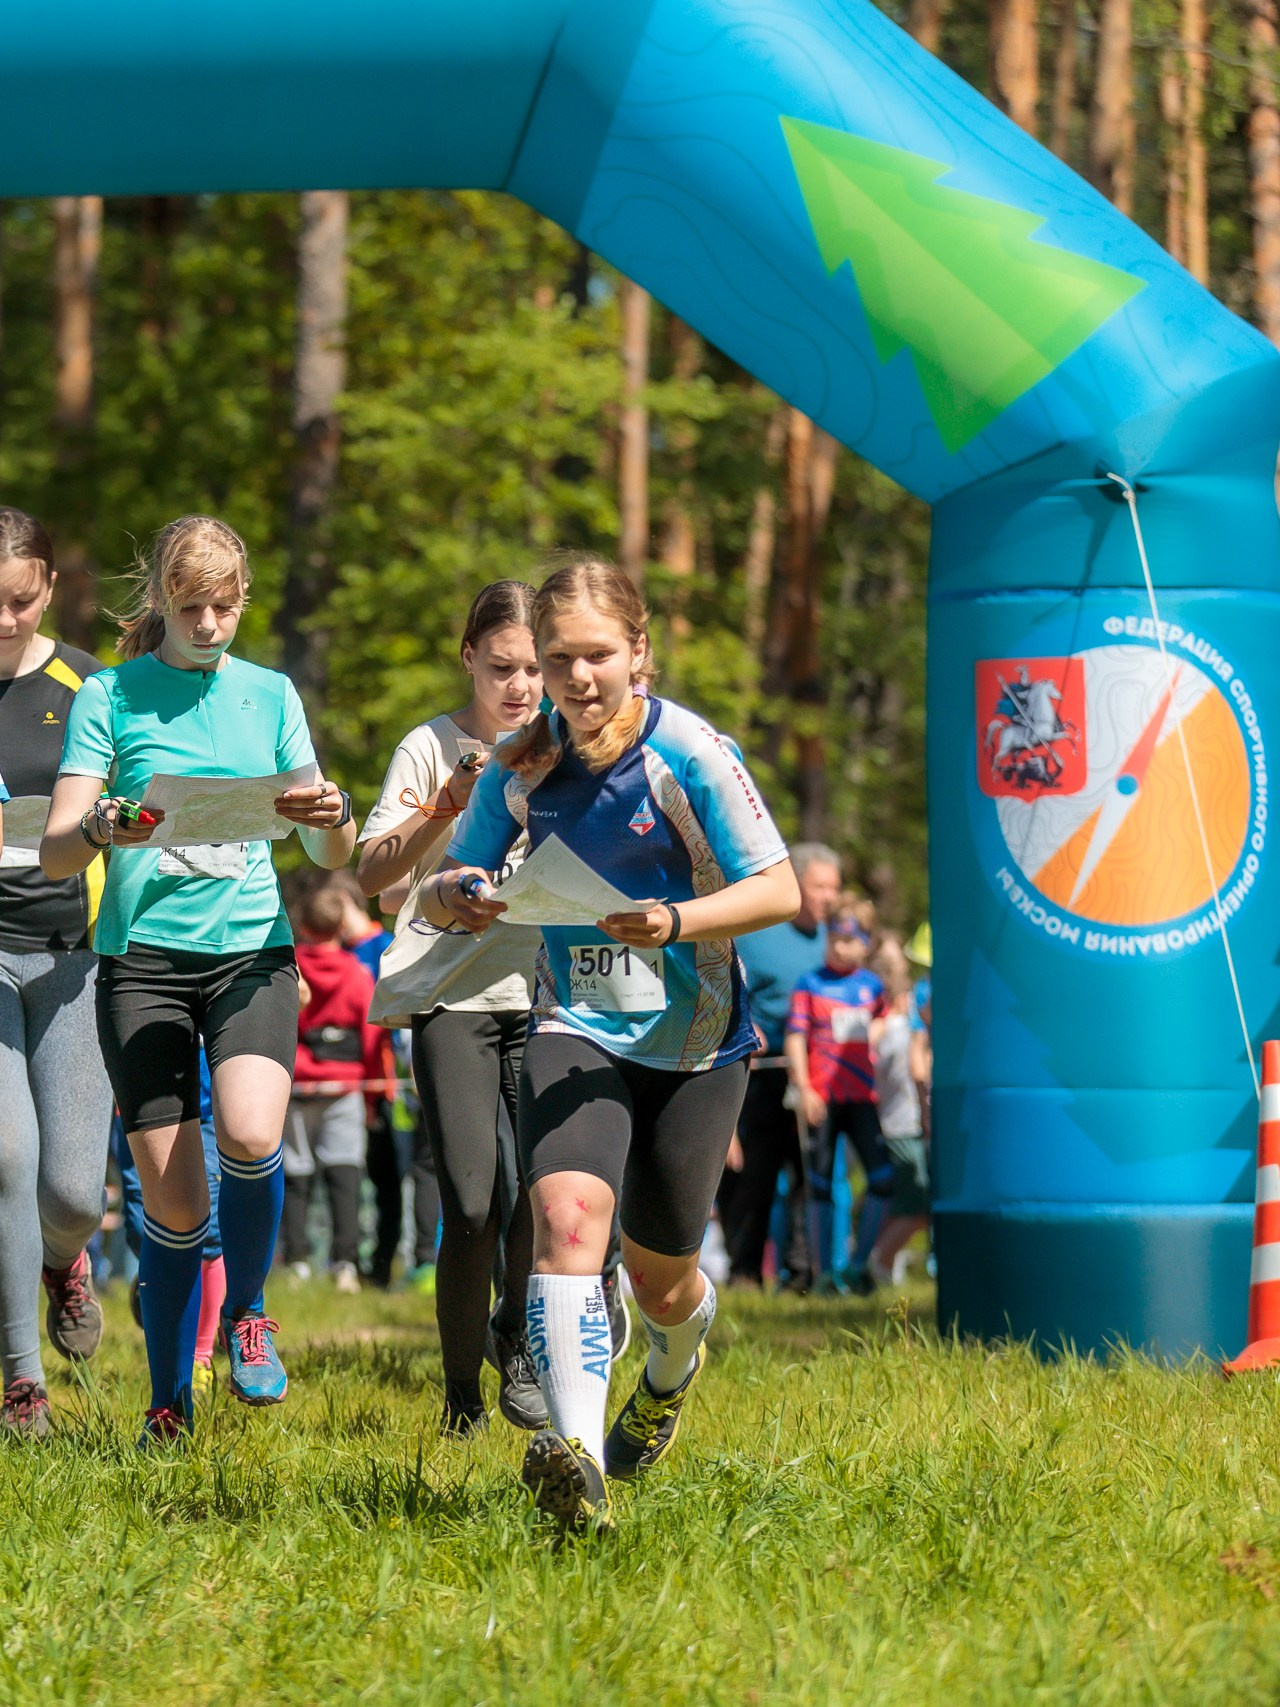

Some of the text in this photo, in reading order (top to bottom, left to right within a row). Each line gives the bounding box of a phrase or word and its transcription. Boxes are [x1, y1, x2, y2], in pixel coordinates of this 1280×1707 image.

[995, 615, 1269, 956] ФЕДЕРАЦИЯ СПОРТИВНОГО ОРИЕНТИРОВАНИЯ МОСКВЫ
[577, 945, 659, 979] 501 1
[570, 979, 597, 991] Ж14
[585, 1296, 597, 1314] GET
[579, 1314, 610, 1382] AWE
